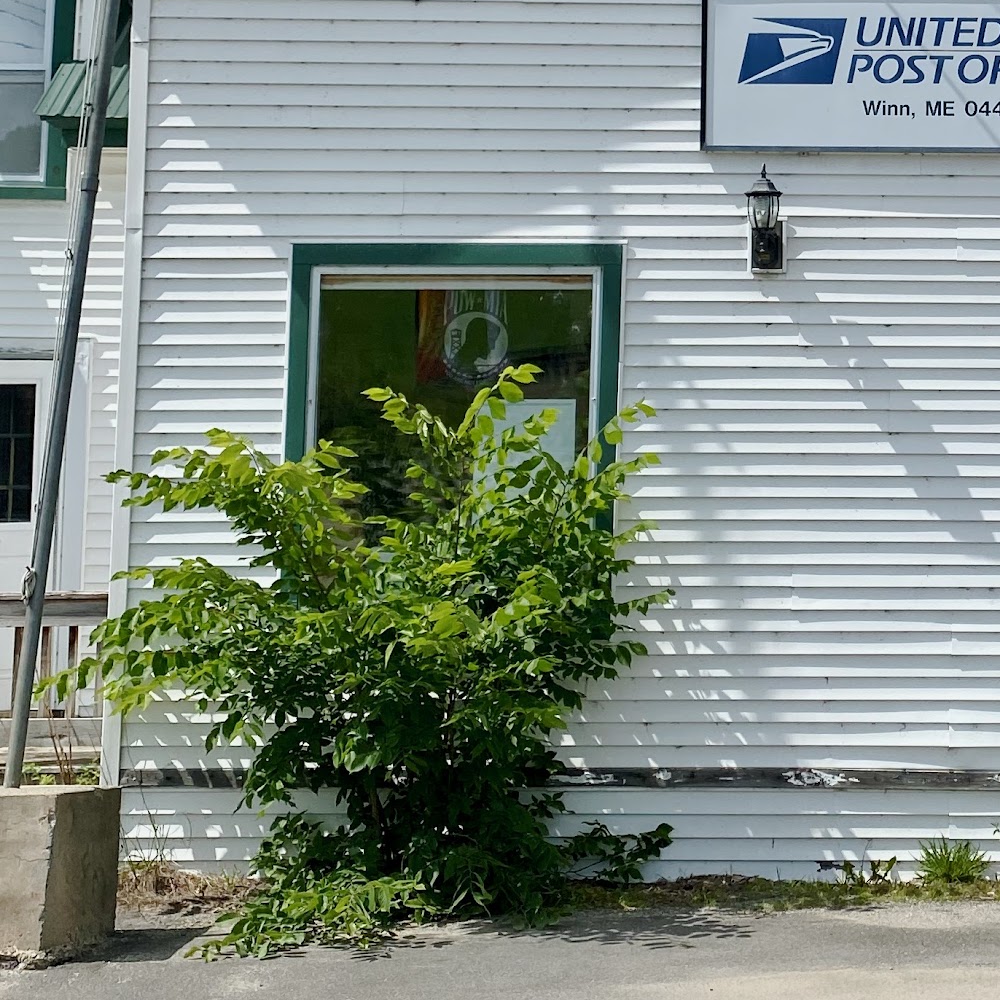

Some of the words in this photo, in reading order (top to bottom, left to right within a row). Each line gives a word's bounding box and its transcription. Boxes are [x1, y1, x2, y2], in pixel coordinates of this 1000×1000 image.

[846, 53, 954, 85] POST
[862, 100, 917, 120] Winn,
[925, 100, 955, 117] ME
